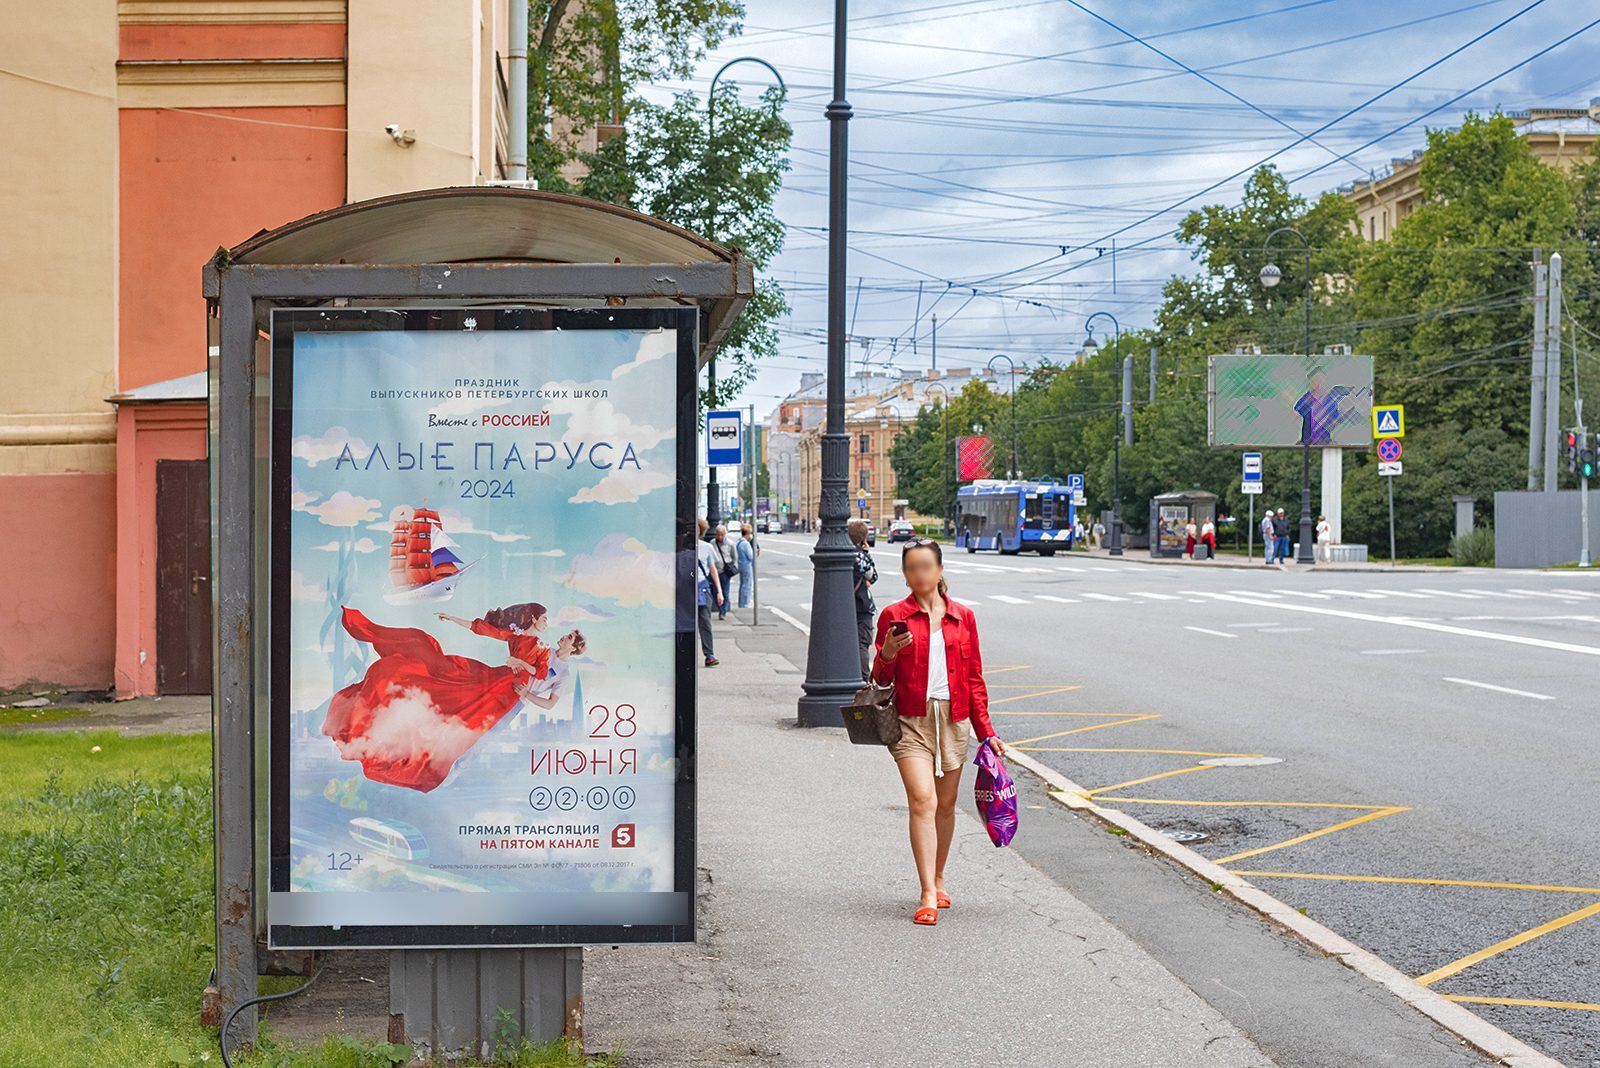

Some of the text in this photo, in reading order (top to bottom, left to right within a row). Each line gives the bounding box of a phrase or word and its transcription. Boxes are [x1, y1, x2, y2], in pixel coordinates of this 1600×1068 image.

[454, 378, 520, 388] ПРАЗДНИК
[370, 389, 609, 399] ВЫПУСКНИКОВ ПЕТЕРБУРГСКИХ ШКОЛ
[428, 410, 550, 428] Вместе с РОССИЕЙ
[335, 442, 642, 471] АЛЫЕ ПАРУСА
[460, 479, 516, 499] 2024
[588, 703, 637, 738] 28
[530, 748, 637, 775] ИЮНЯ
[531, 787, 634, 809] 22:00
[458, 824, 600, 837] ПРЯМАЯ ТРАНСЛЯЦИЯ
[616, 827, 632, 846] 5
[480, 838, 600, 849] НА ПЯТОМ КАНАЛЕ
[327, 852, 364, 870] 12+
